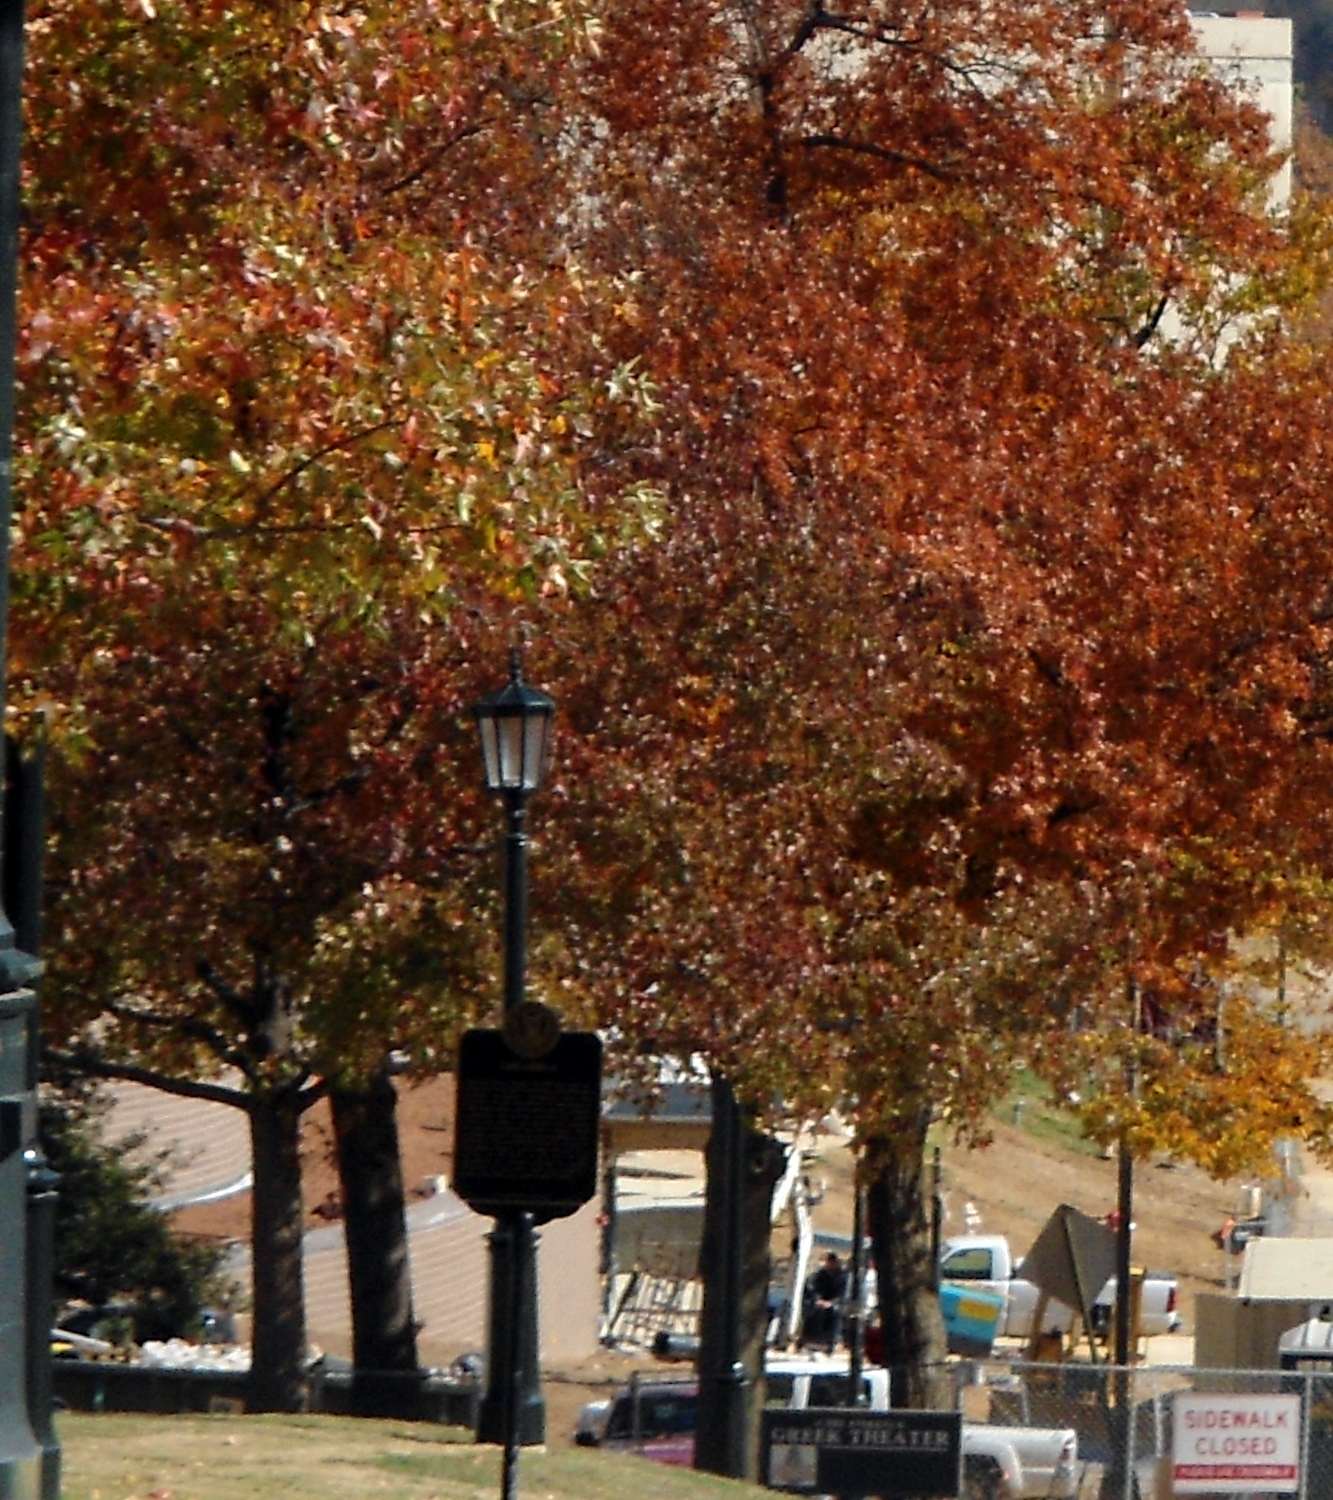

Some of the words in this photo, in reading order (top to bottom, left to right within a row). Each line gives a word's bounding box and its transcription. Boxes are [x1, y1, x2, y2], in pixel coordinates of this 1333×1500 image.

[1185, 1409, 1288, 1429] SIDEWALK
[771, 1426, 841, 1444] GREEK
[850, 1428, 949, 1446] THEATER
[1195, 1437, 1277, 1455] CLOSED
